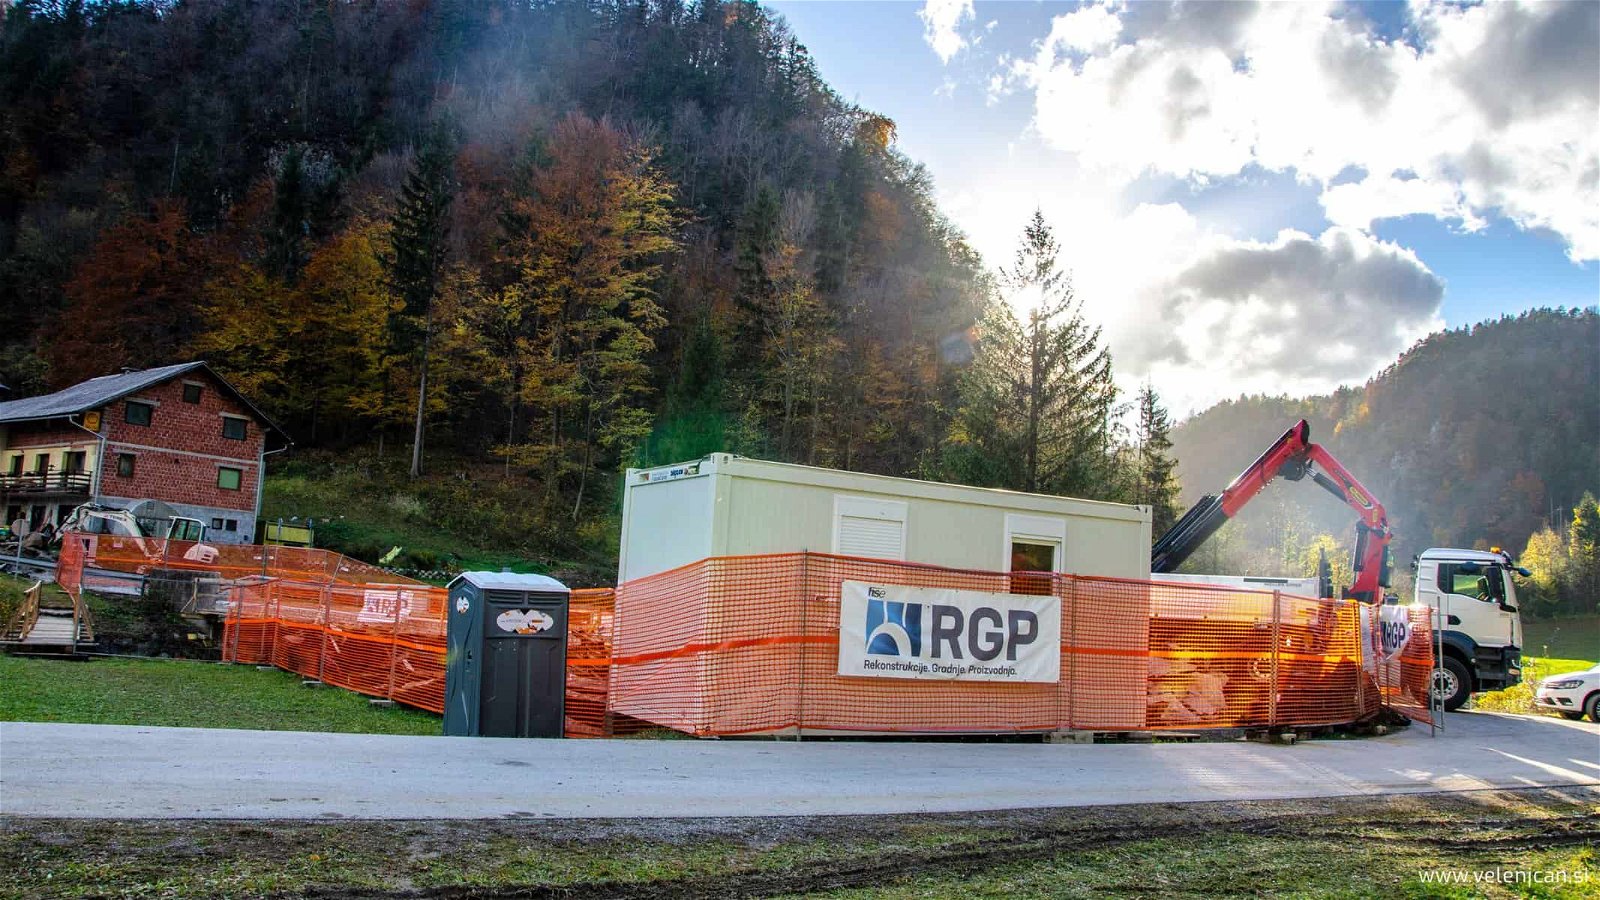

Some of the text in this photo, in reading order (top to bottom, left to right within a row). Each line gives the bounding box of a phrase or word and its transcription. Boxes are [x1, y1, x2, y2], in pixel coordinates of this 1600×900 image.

[931, 604, 1039, 662] RGP
[1386, 621, 1406, 649] RGP
[863, 659, 1017, 677] Rekonstrukcije. Gradnje. Proizvodnja.
